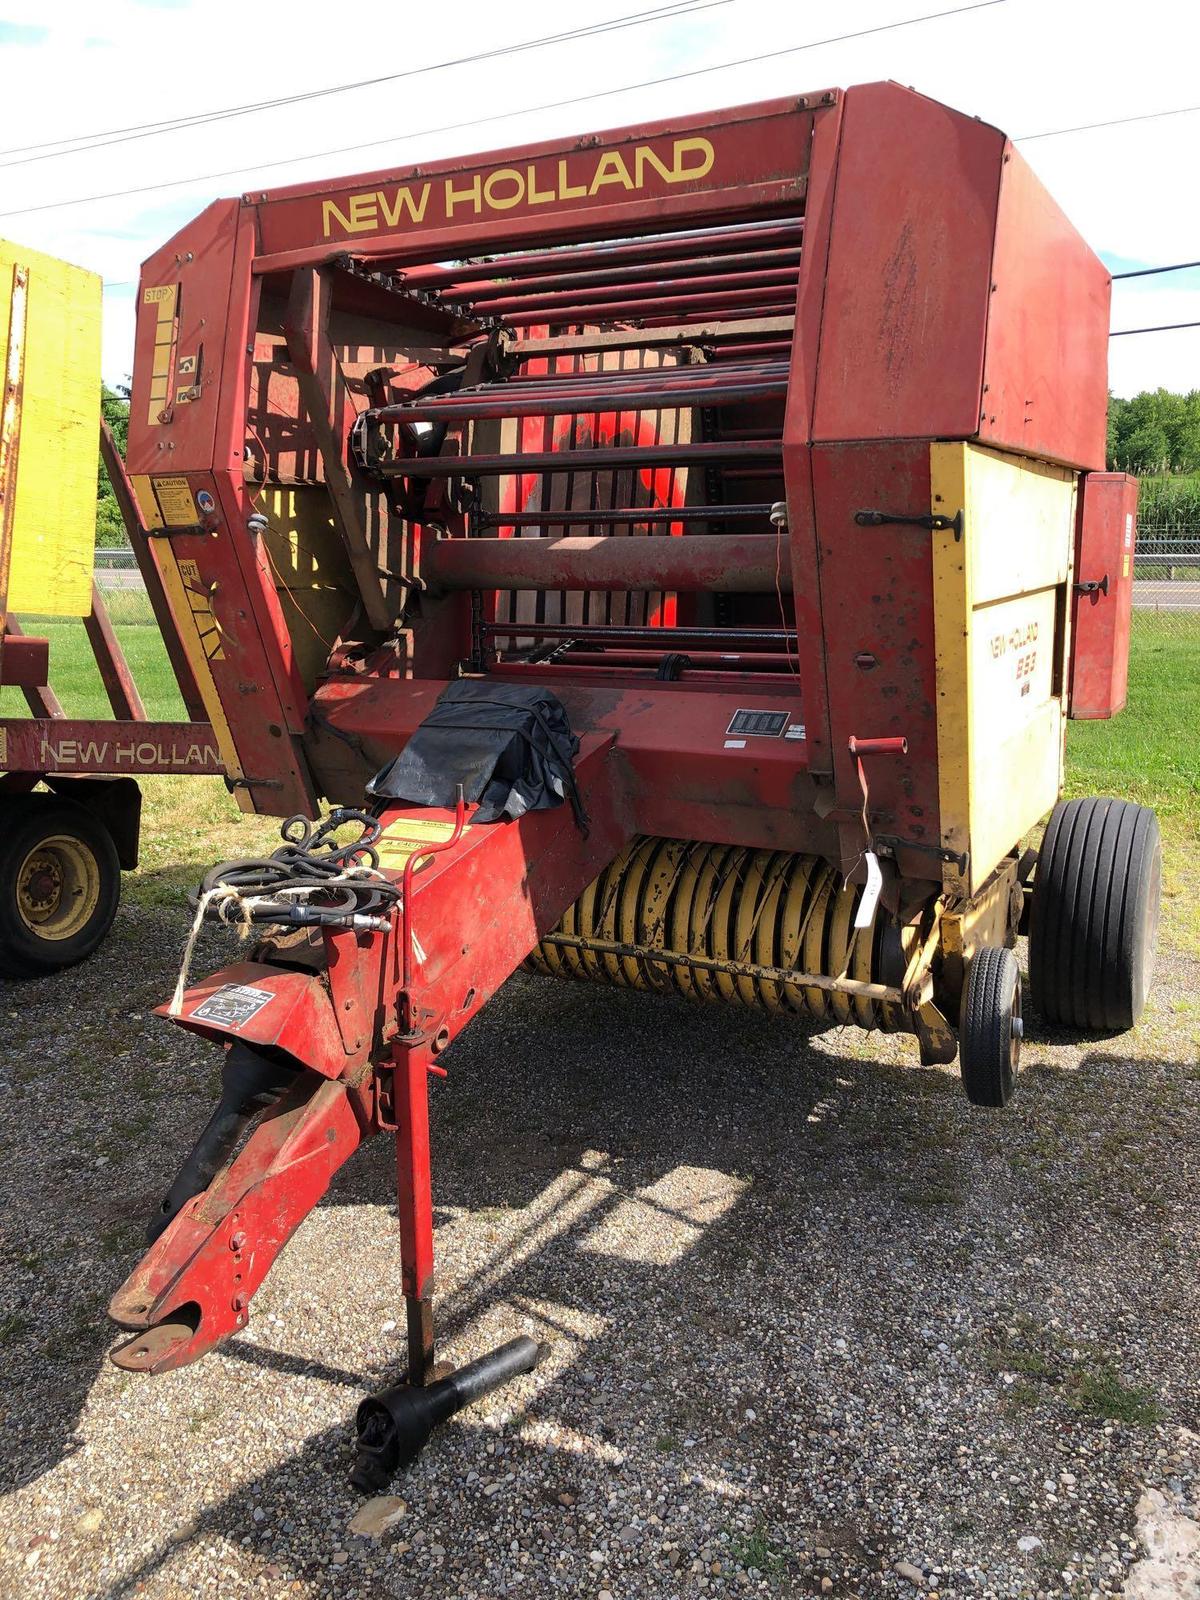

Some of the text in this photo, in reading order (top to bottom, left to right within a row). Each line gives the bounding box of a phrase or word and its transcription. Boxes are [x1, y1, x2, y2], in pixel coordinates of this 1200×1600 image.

[322, 136, 715, 237] NEW HOLLAND
[146, 289, 168, 301] STOP
[180, 565, 196, 576] CUT
[40, 740, 224, 765] NEW HOLLAN
